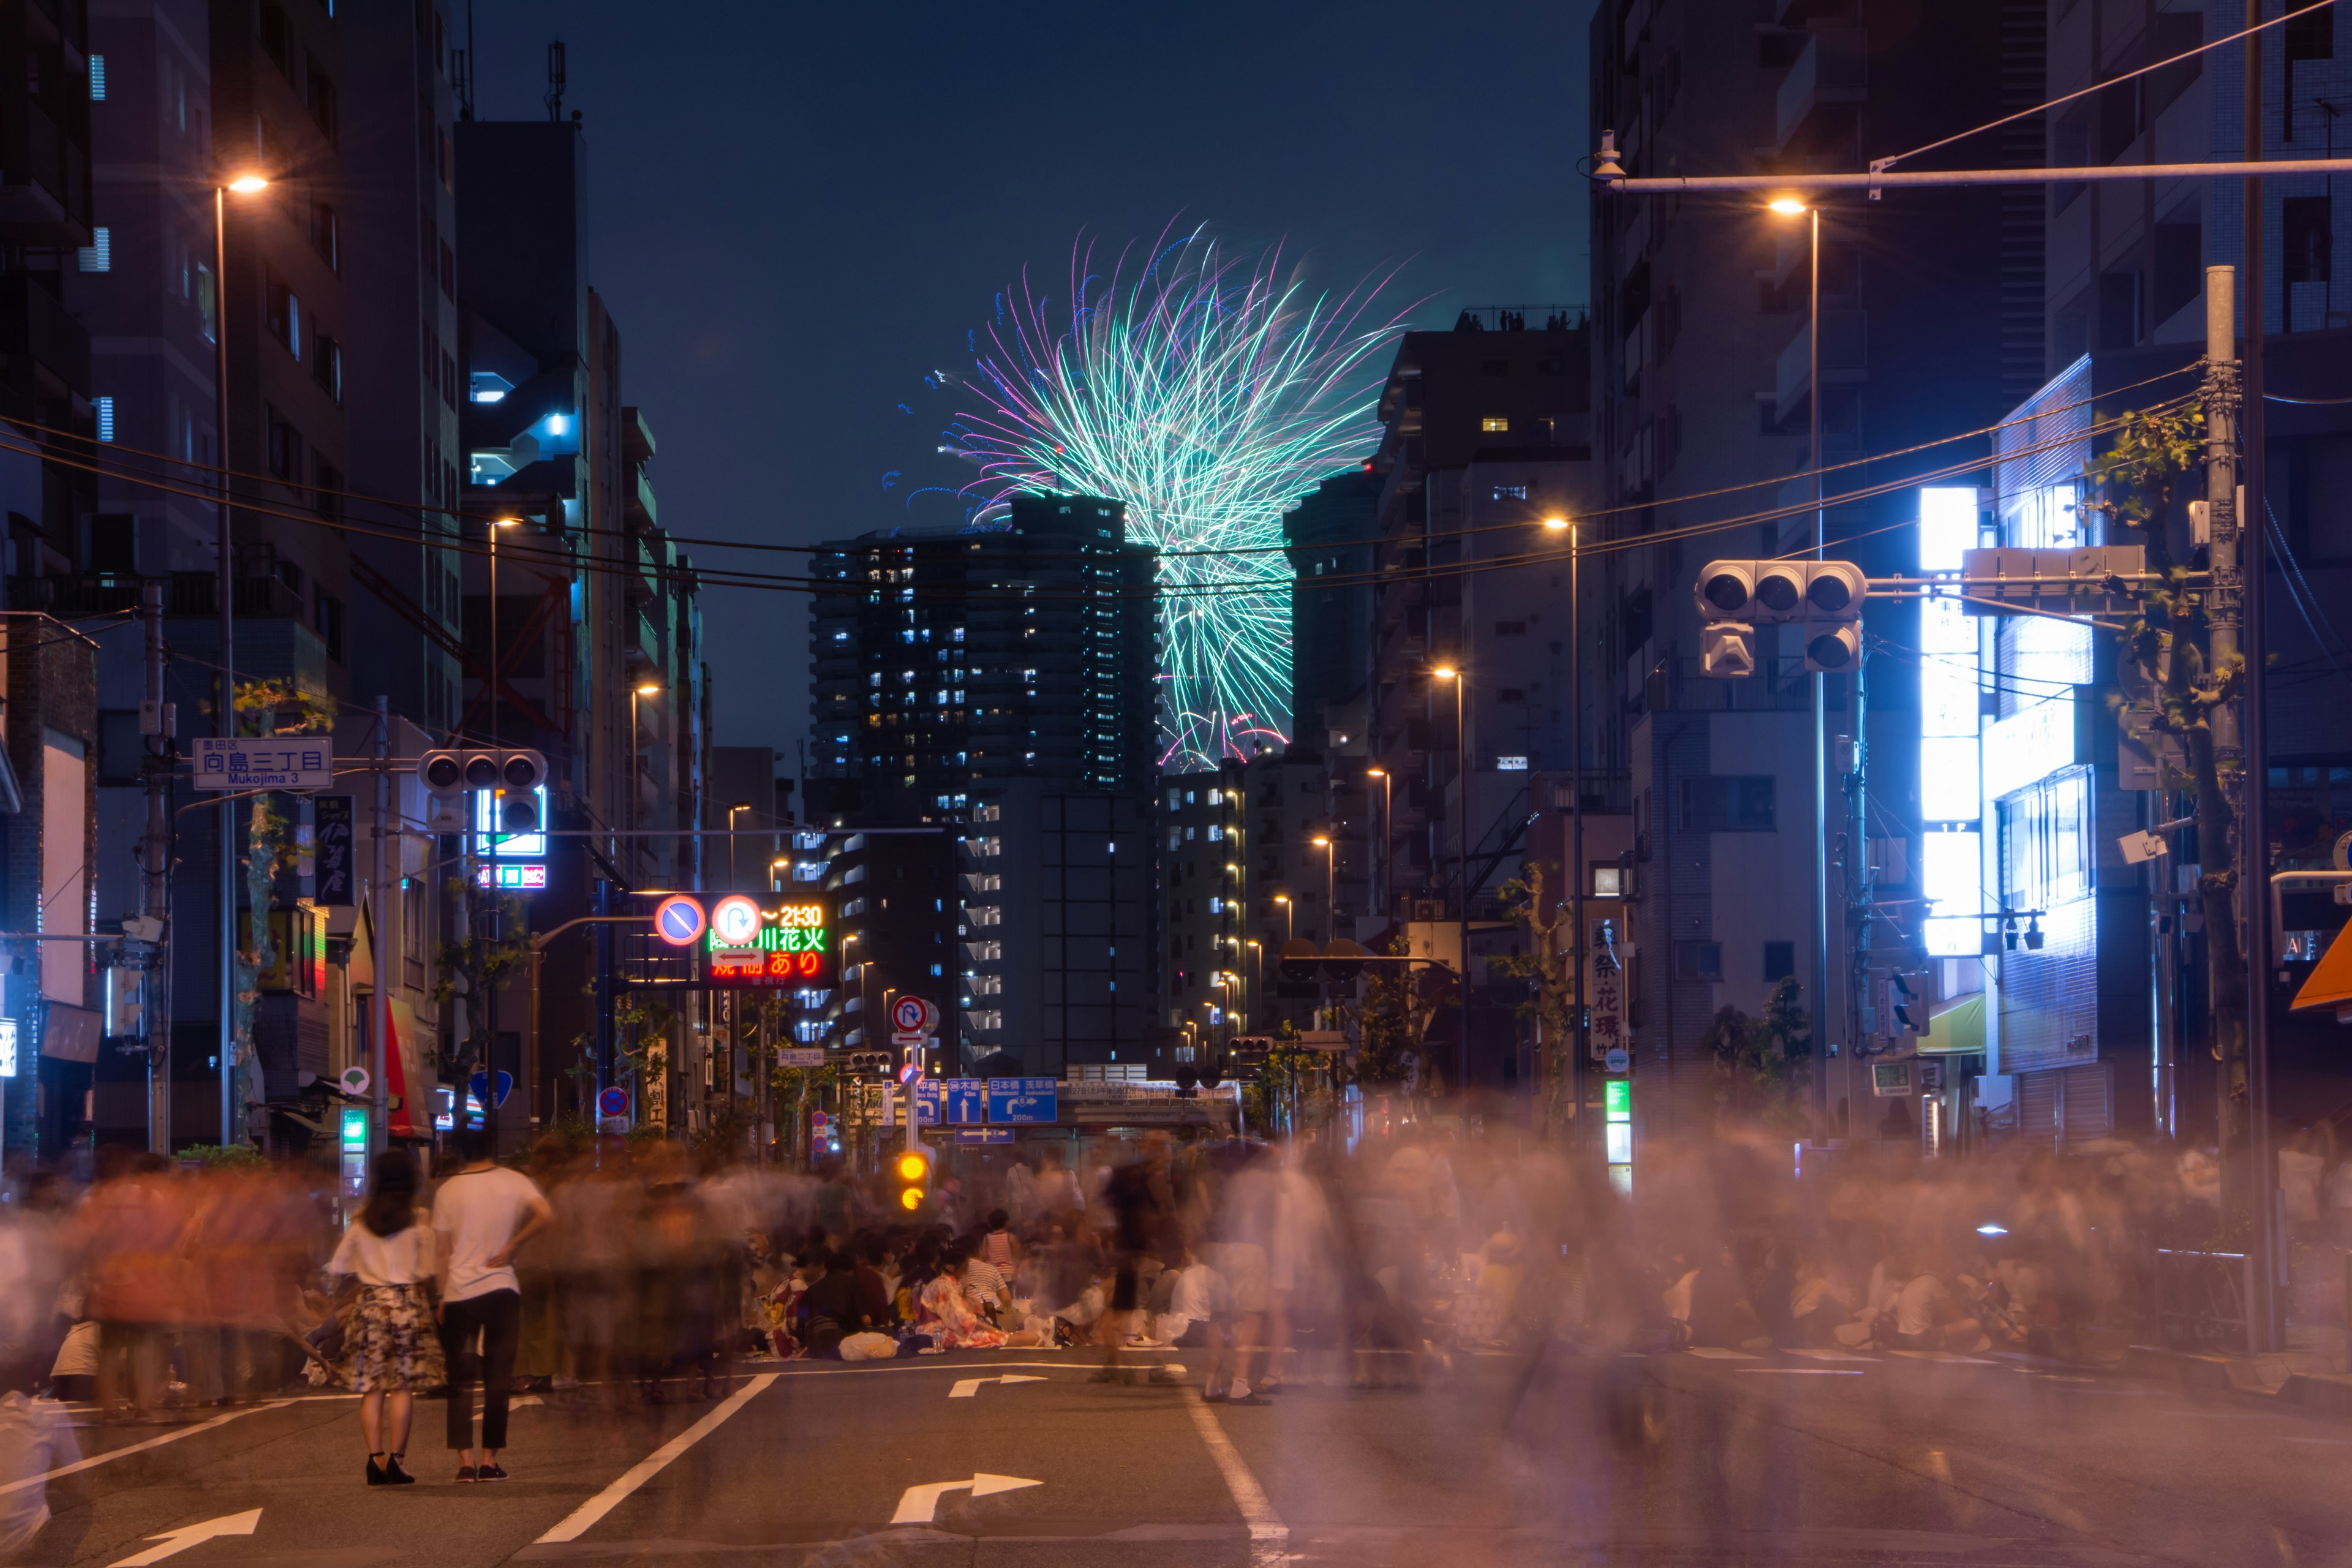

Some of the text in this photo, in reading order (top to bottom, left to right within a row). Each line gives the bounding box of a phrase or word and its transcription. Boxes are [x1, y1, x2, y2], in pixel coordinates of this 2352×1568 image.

[203, 740, 238, 750] 墨田区
[204, 752, 322, 772] 向島三丁目
[228, 773, 298, 786] Mukojima 3
[709, 927, 824, 951] 川花火
[752, 976, 785, 986] 警視庁
[918, 1082, 938, 1091] 平橋
[960, 1081, 979, 1090] 木場
[991, 1080, 1019, 1090] 日本橋
[1025, 1080, 1054, 1090] 浅草橋
